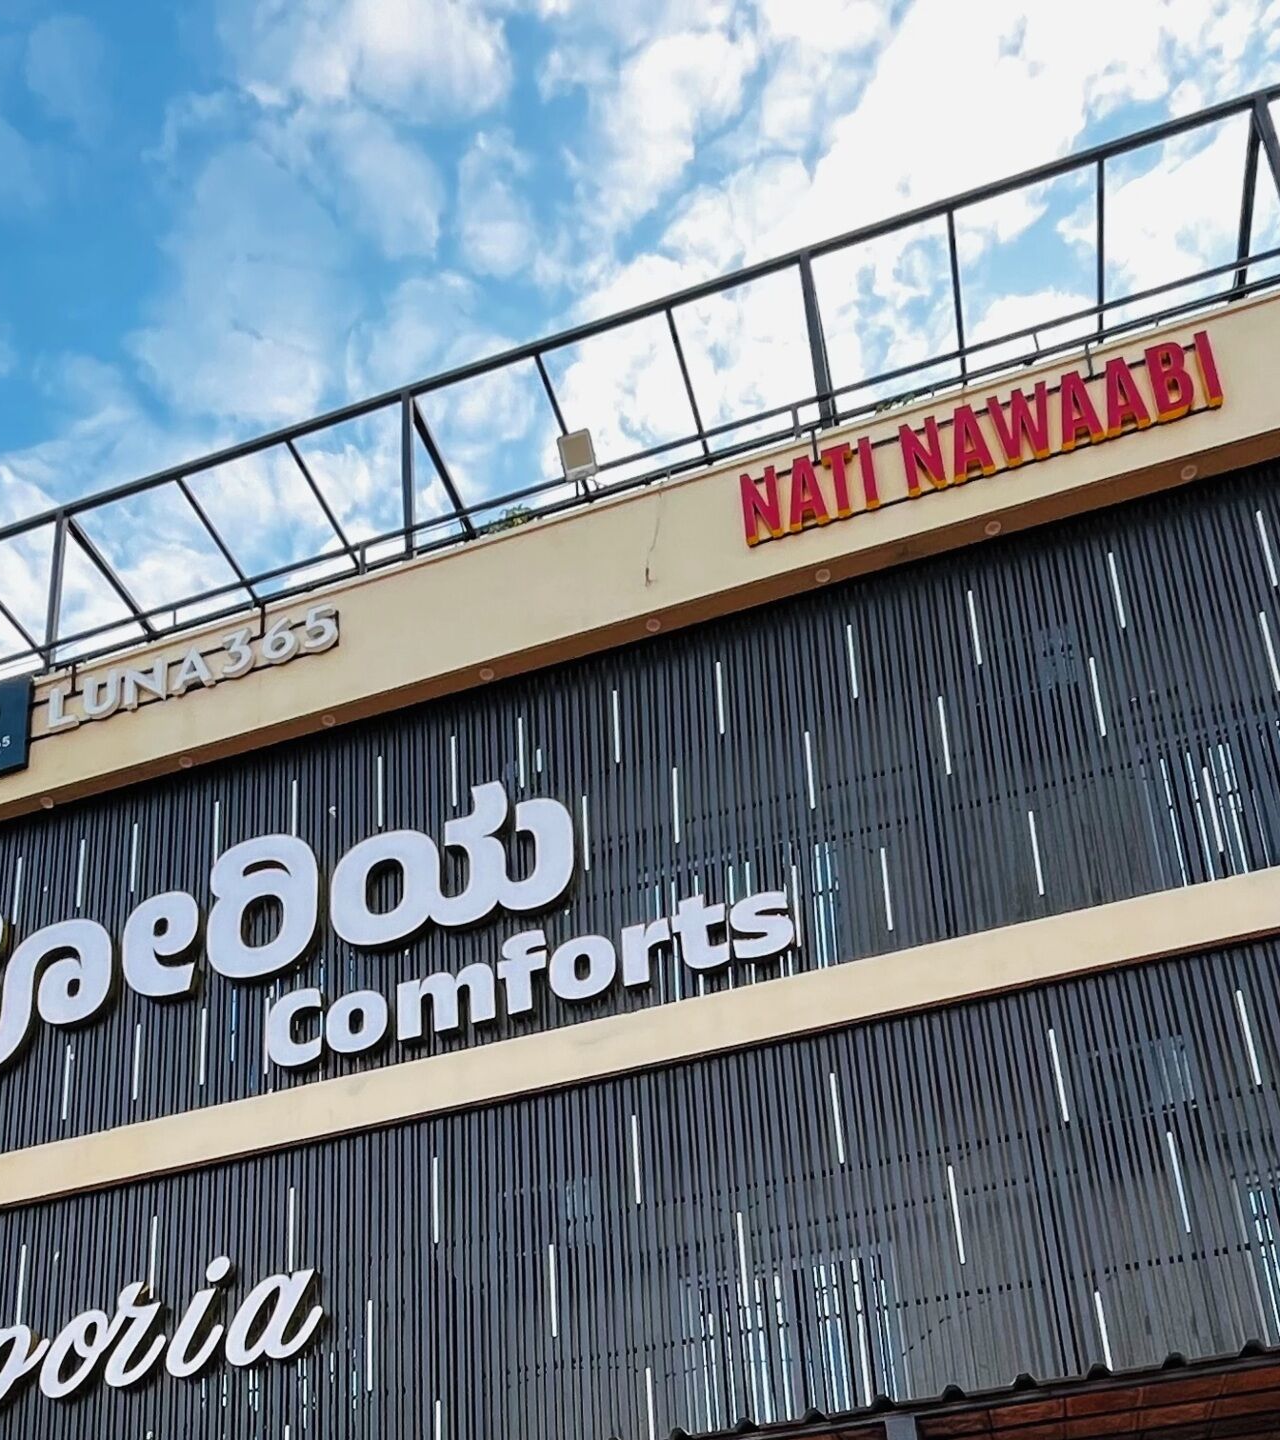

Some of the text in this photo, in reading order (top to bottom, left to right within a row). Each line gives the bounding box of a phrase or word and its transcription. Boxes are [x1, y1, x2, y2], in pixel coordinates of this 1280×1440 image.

[739, 330, 1224, 547] NATI NAWAABI
[266, 890, 796, 1069] comforts
